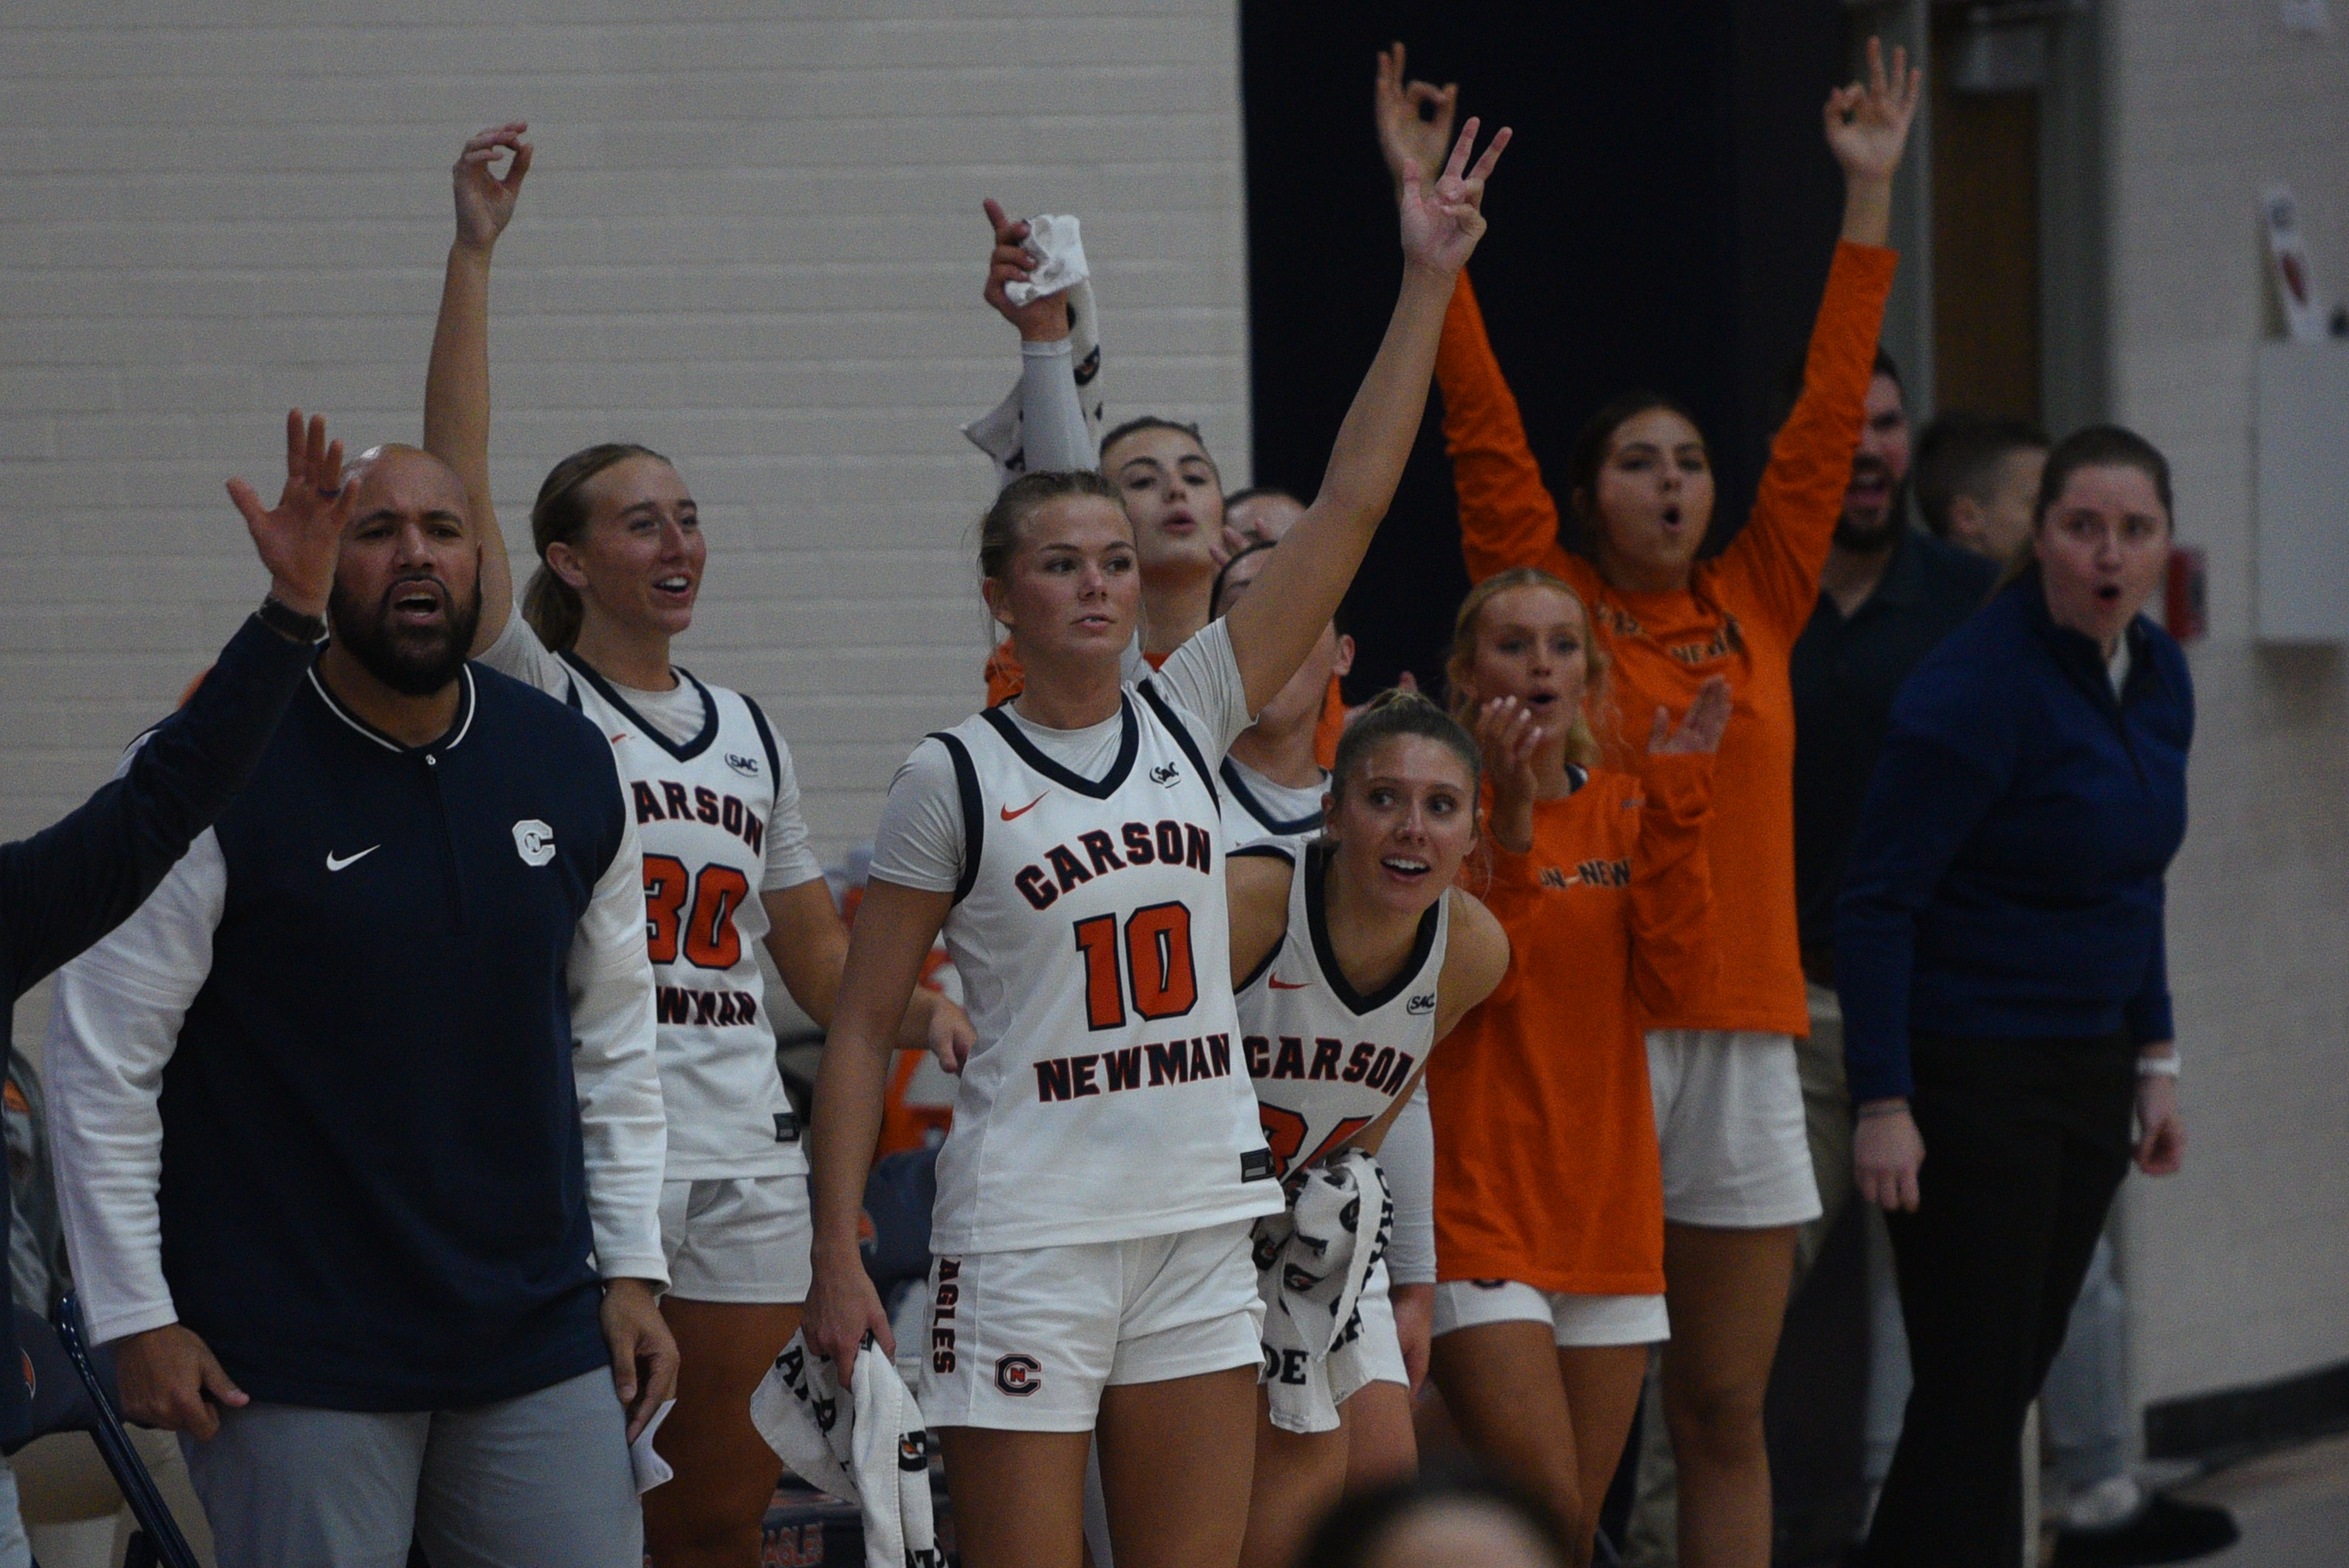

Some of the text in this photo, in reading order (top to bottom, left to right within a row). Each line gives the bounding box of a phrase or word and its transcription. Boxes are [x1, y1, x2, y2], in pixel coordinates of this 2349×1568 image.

[729, 754, 759, 773] SAC
[630, 780, 763, 857] ARSON
[1014, 820, 1211, 911] CARSON
[642, 852, 749, 970] 30
[1073, 901, 1198, 1032] 10
[656, 985, 757, 1027] WMAN
[1033, 1033, 1231, 1103] NEWMAN
[1242, 1035, 1414, 1097] CARSON
[931, 1257, 961, 1374] AGLES
